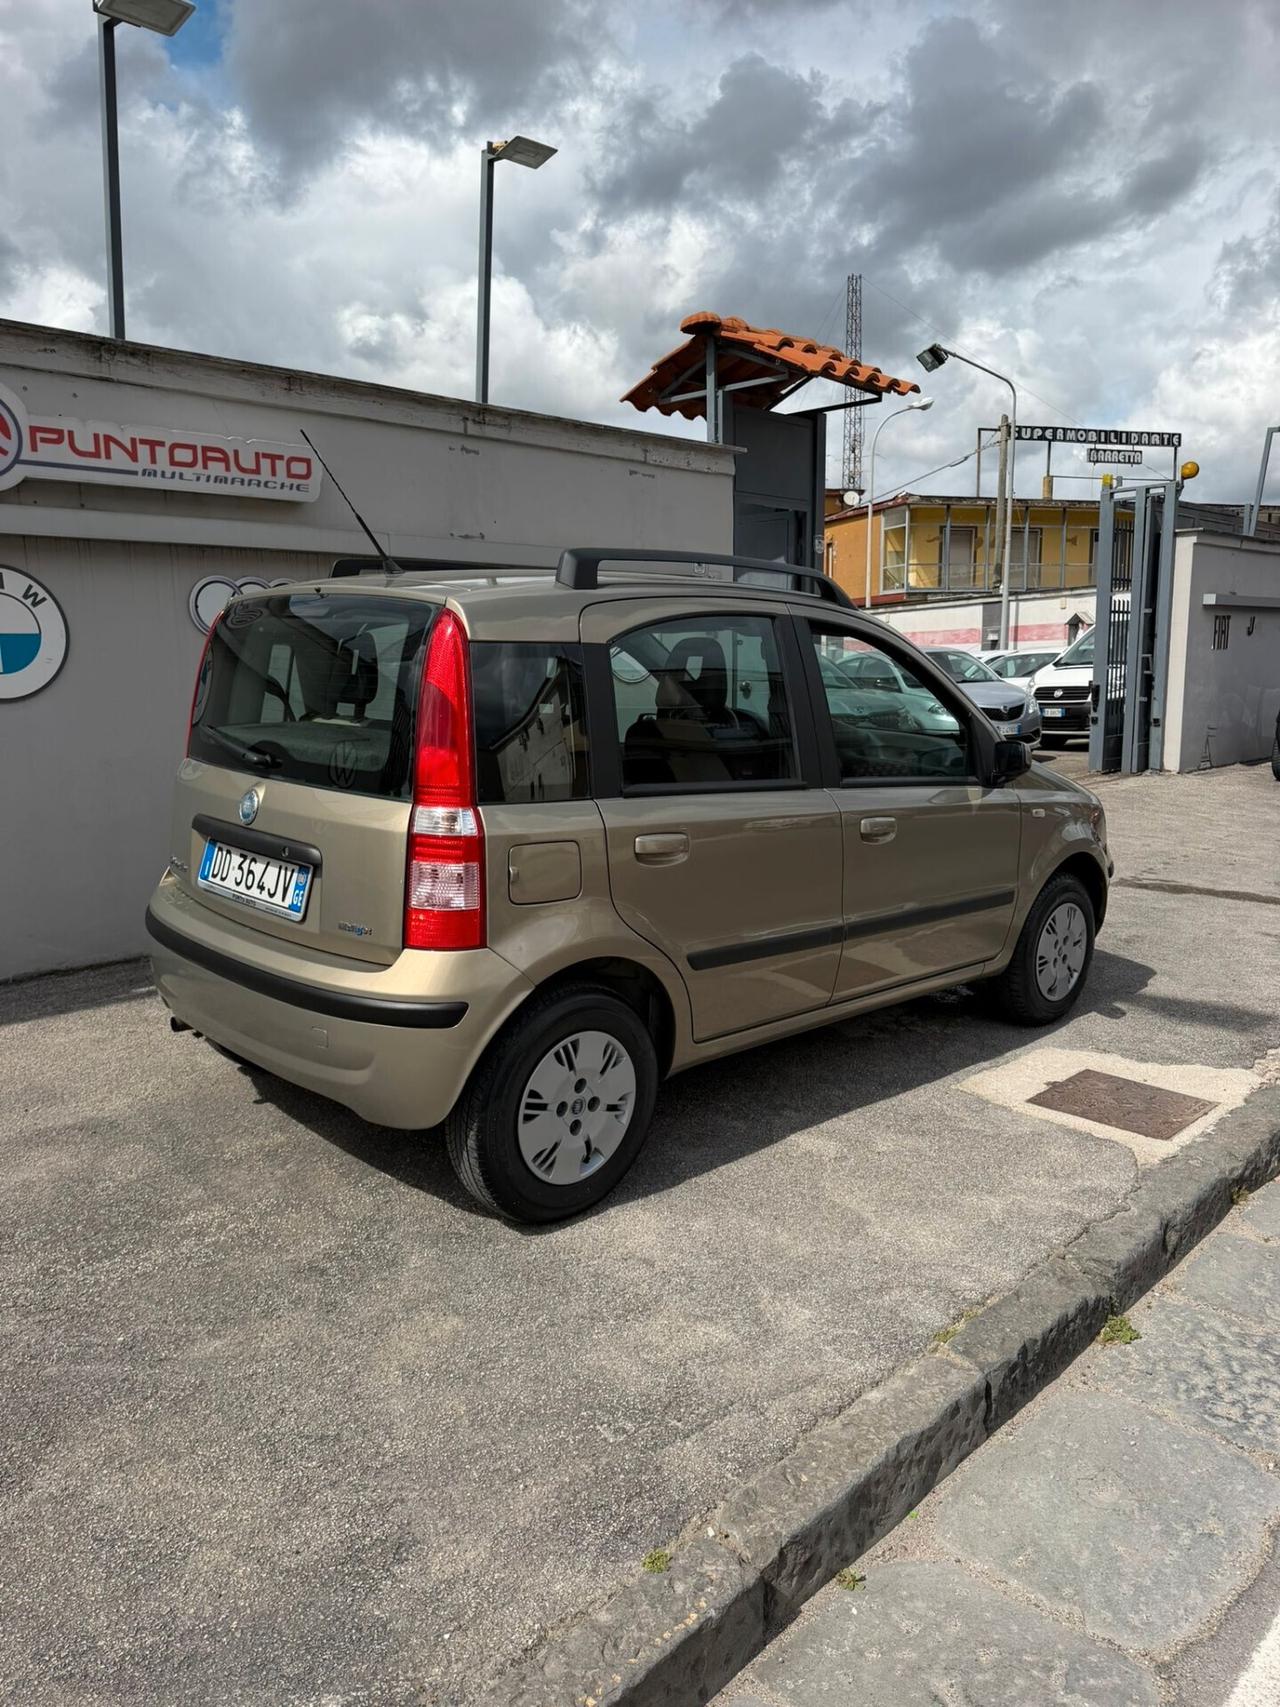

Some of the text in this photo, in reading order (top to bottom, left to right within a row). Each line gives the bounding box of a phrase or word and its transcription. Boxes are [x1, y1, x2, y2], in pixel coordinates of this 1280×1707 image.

[28, 425, 312, 481] PUNTOAUTO
[1090, 450, 1141, 463] BARRETTA
[140, 467, 310, 493] MULTIMARCHE
[1212, 615, 1231, 650] FIAT
[210, 846, 296, 903] DD 364JV
